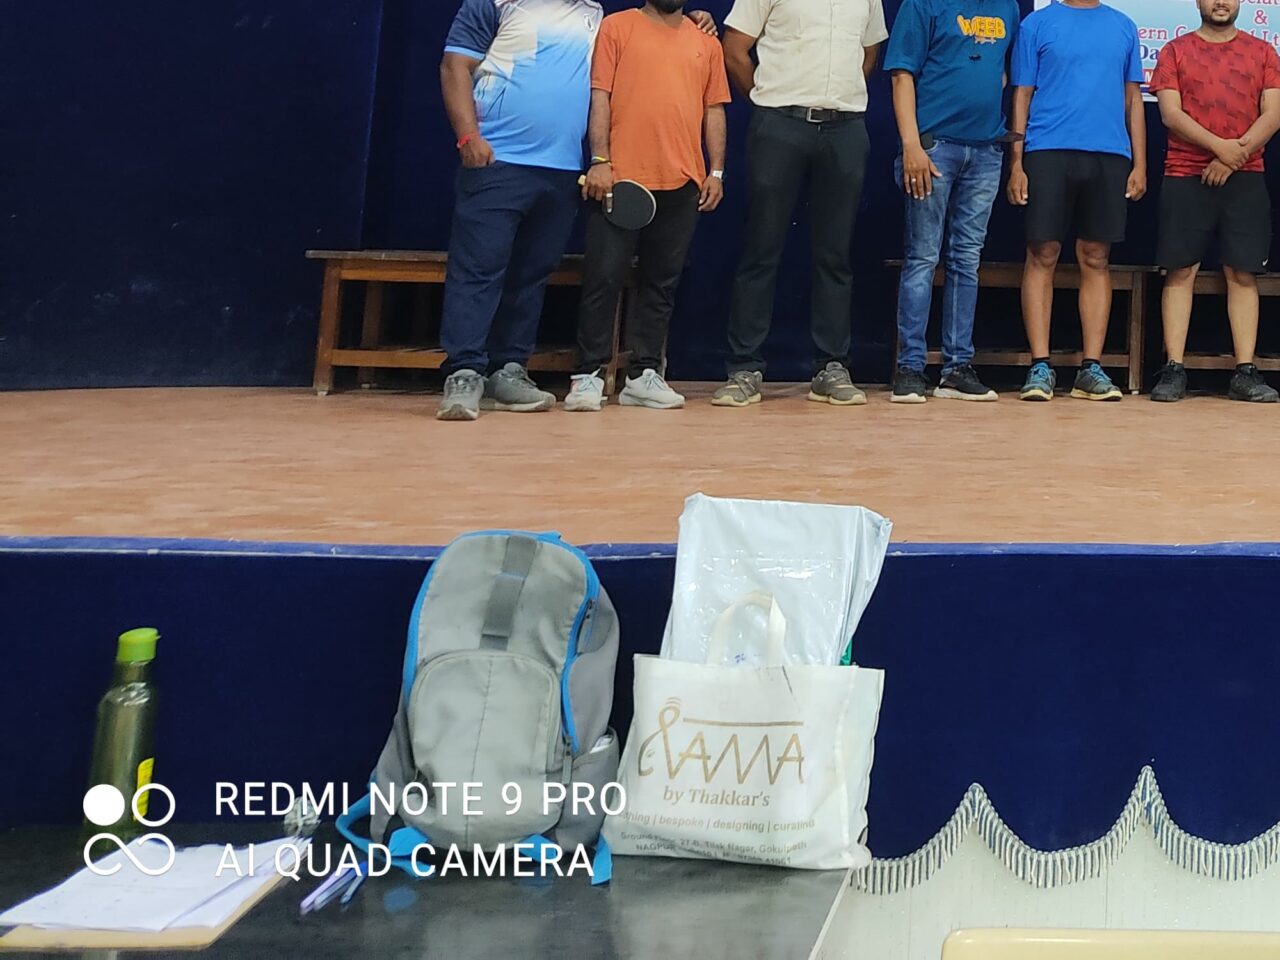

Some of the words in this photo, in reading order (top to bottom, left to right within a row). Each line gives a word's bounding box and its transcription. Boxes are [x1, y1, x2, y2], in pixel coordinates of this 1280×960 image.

[956, 14, 1006, 39] WEEB
[1254, 10, 1268, 25] &
[664, 785, 684, 806] by
[689, 787, 771, 807] Thakkar's
[712, 818, 765, 833] designing
